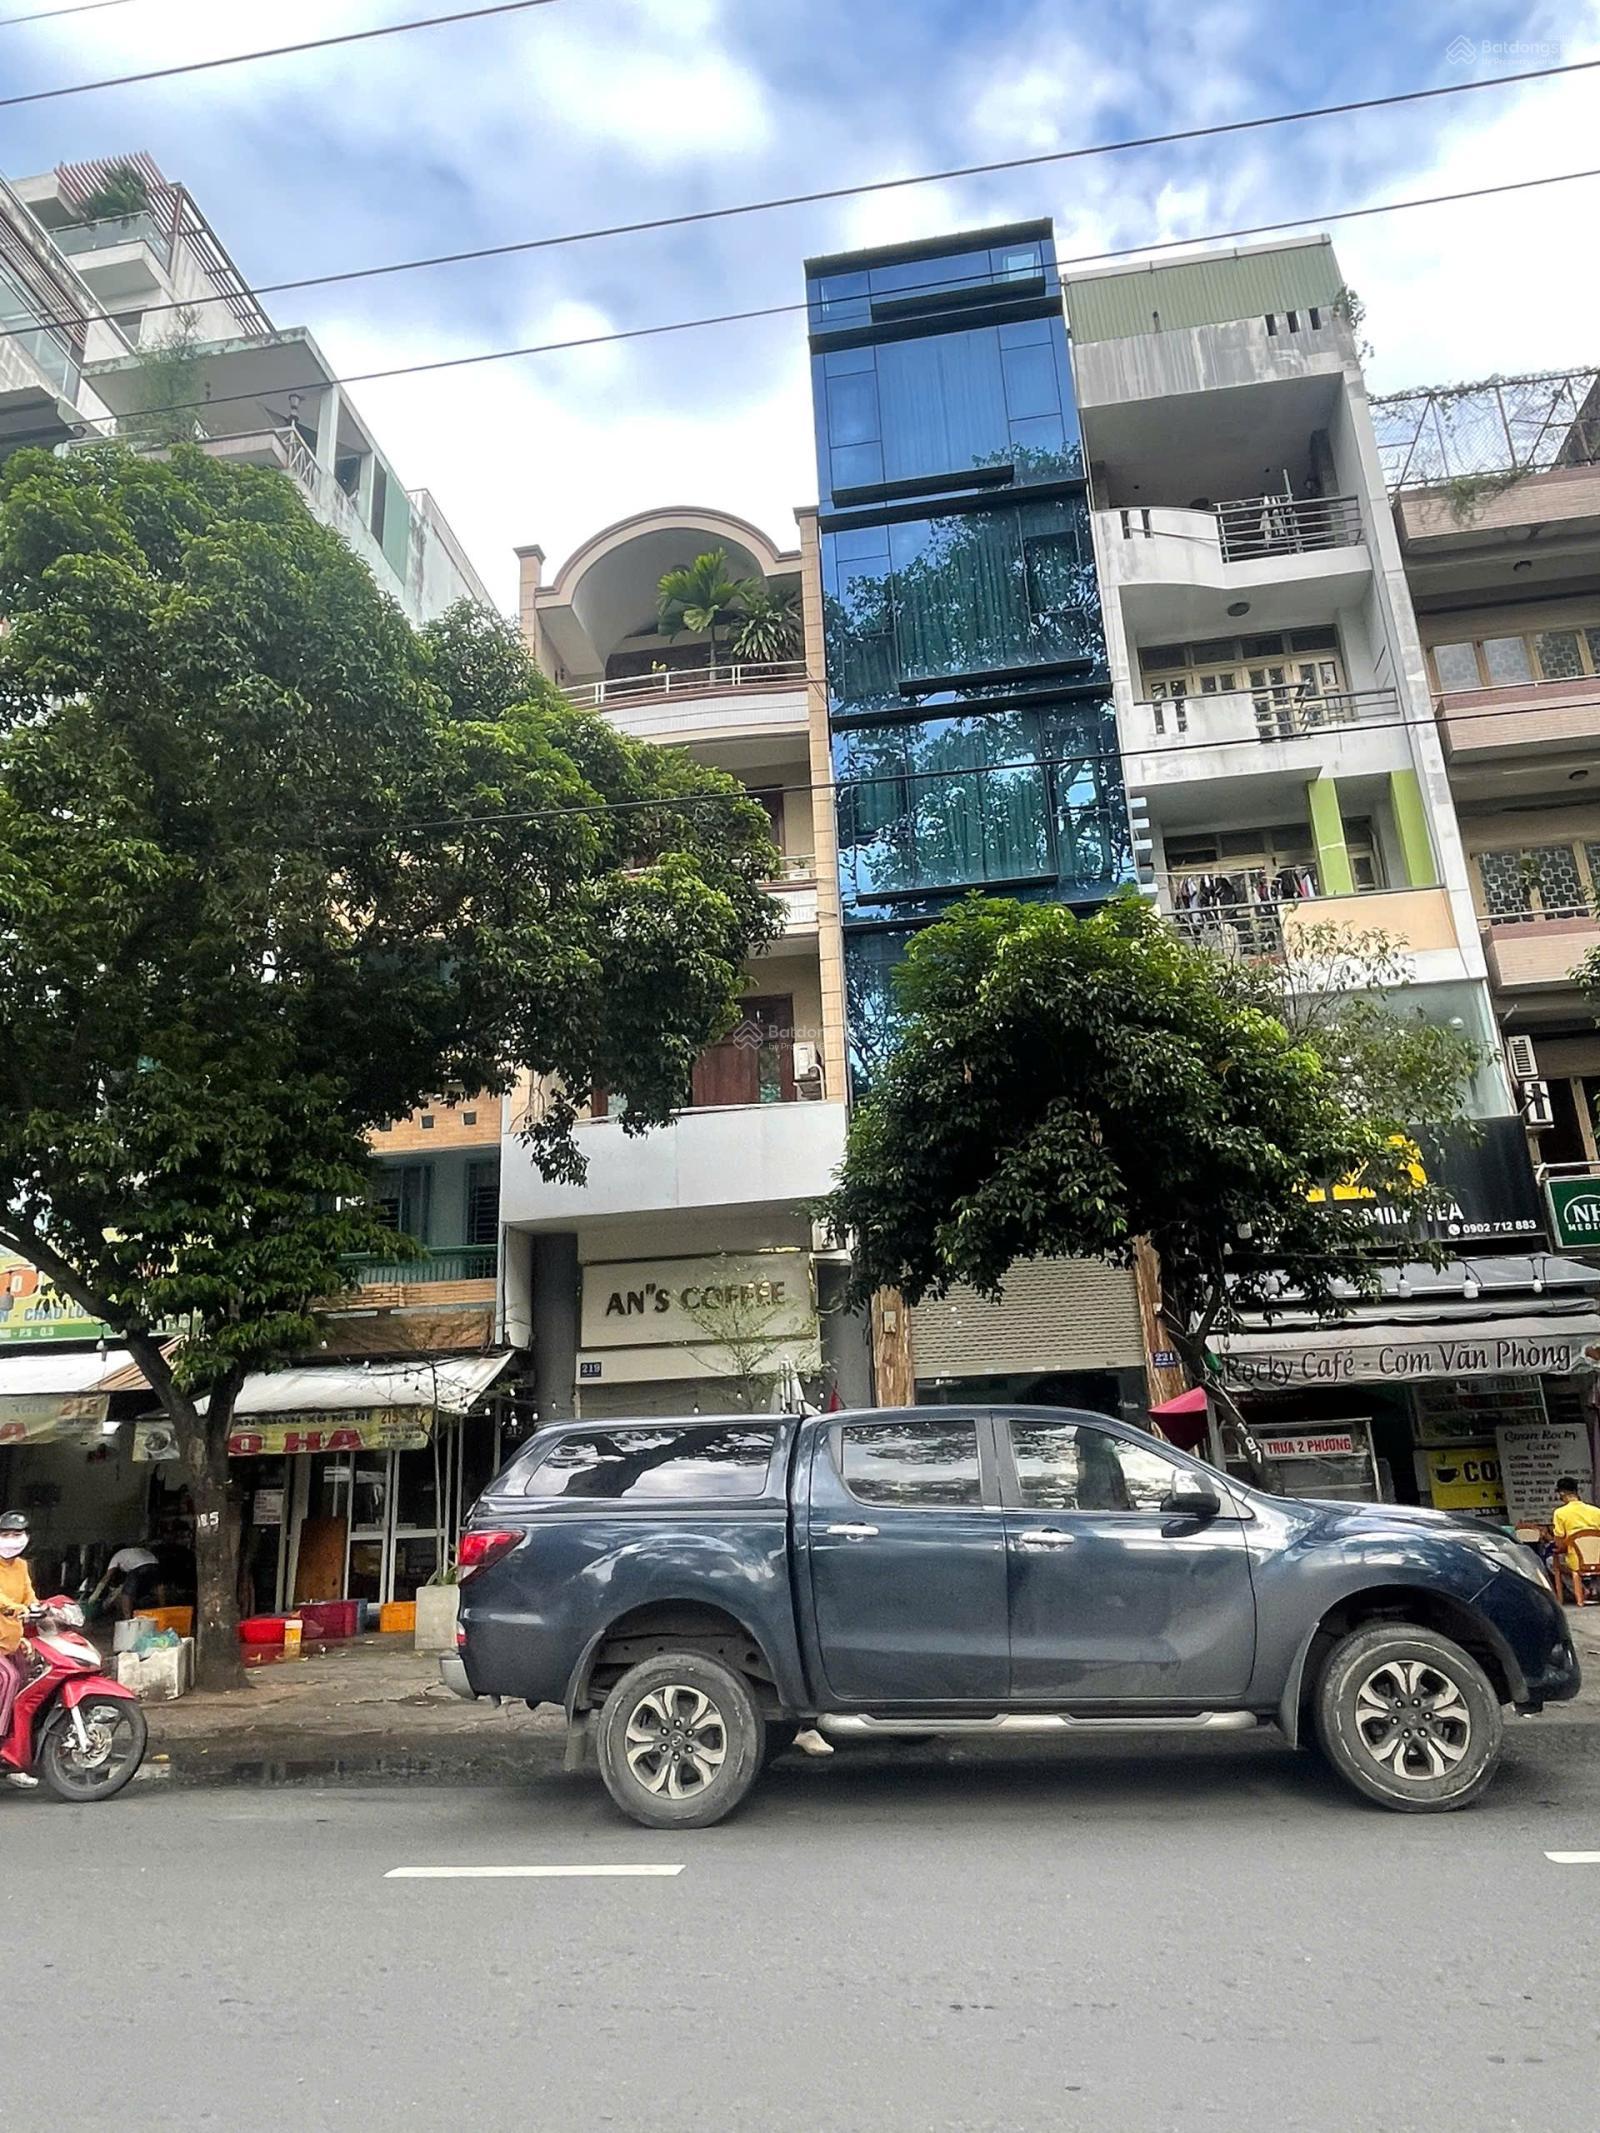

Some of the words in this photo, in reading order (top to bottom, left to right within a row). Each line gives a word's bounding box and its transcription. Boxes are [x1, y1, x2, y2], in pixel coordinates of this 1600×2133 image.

[1462, 1223, 1491, 1234] 0902
[1493, 1221, 1513, 1232] 712
[1515, 1219, 1537, 1230] 883
[1568, 1222, 1600, 1231] MEDI
[680, 1281, 786, 1311] COFFEE
[1154, 1352, 1173, 1361] 221
[1225, 1354, 1294, 1386] Rocky
[1302, 1350, 1355, 1383] Café
[1379, 1346, 1433, 1375] Cơm
[1438, 1343, 1490, 1372] Văn
[1496, 1339, 1571, 1371] Phòng
[582, 1363, 600, 1373] 219
[1297, 1440, 1305, 1453] 2
[1463, 1460, 1501, 1483] CO
